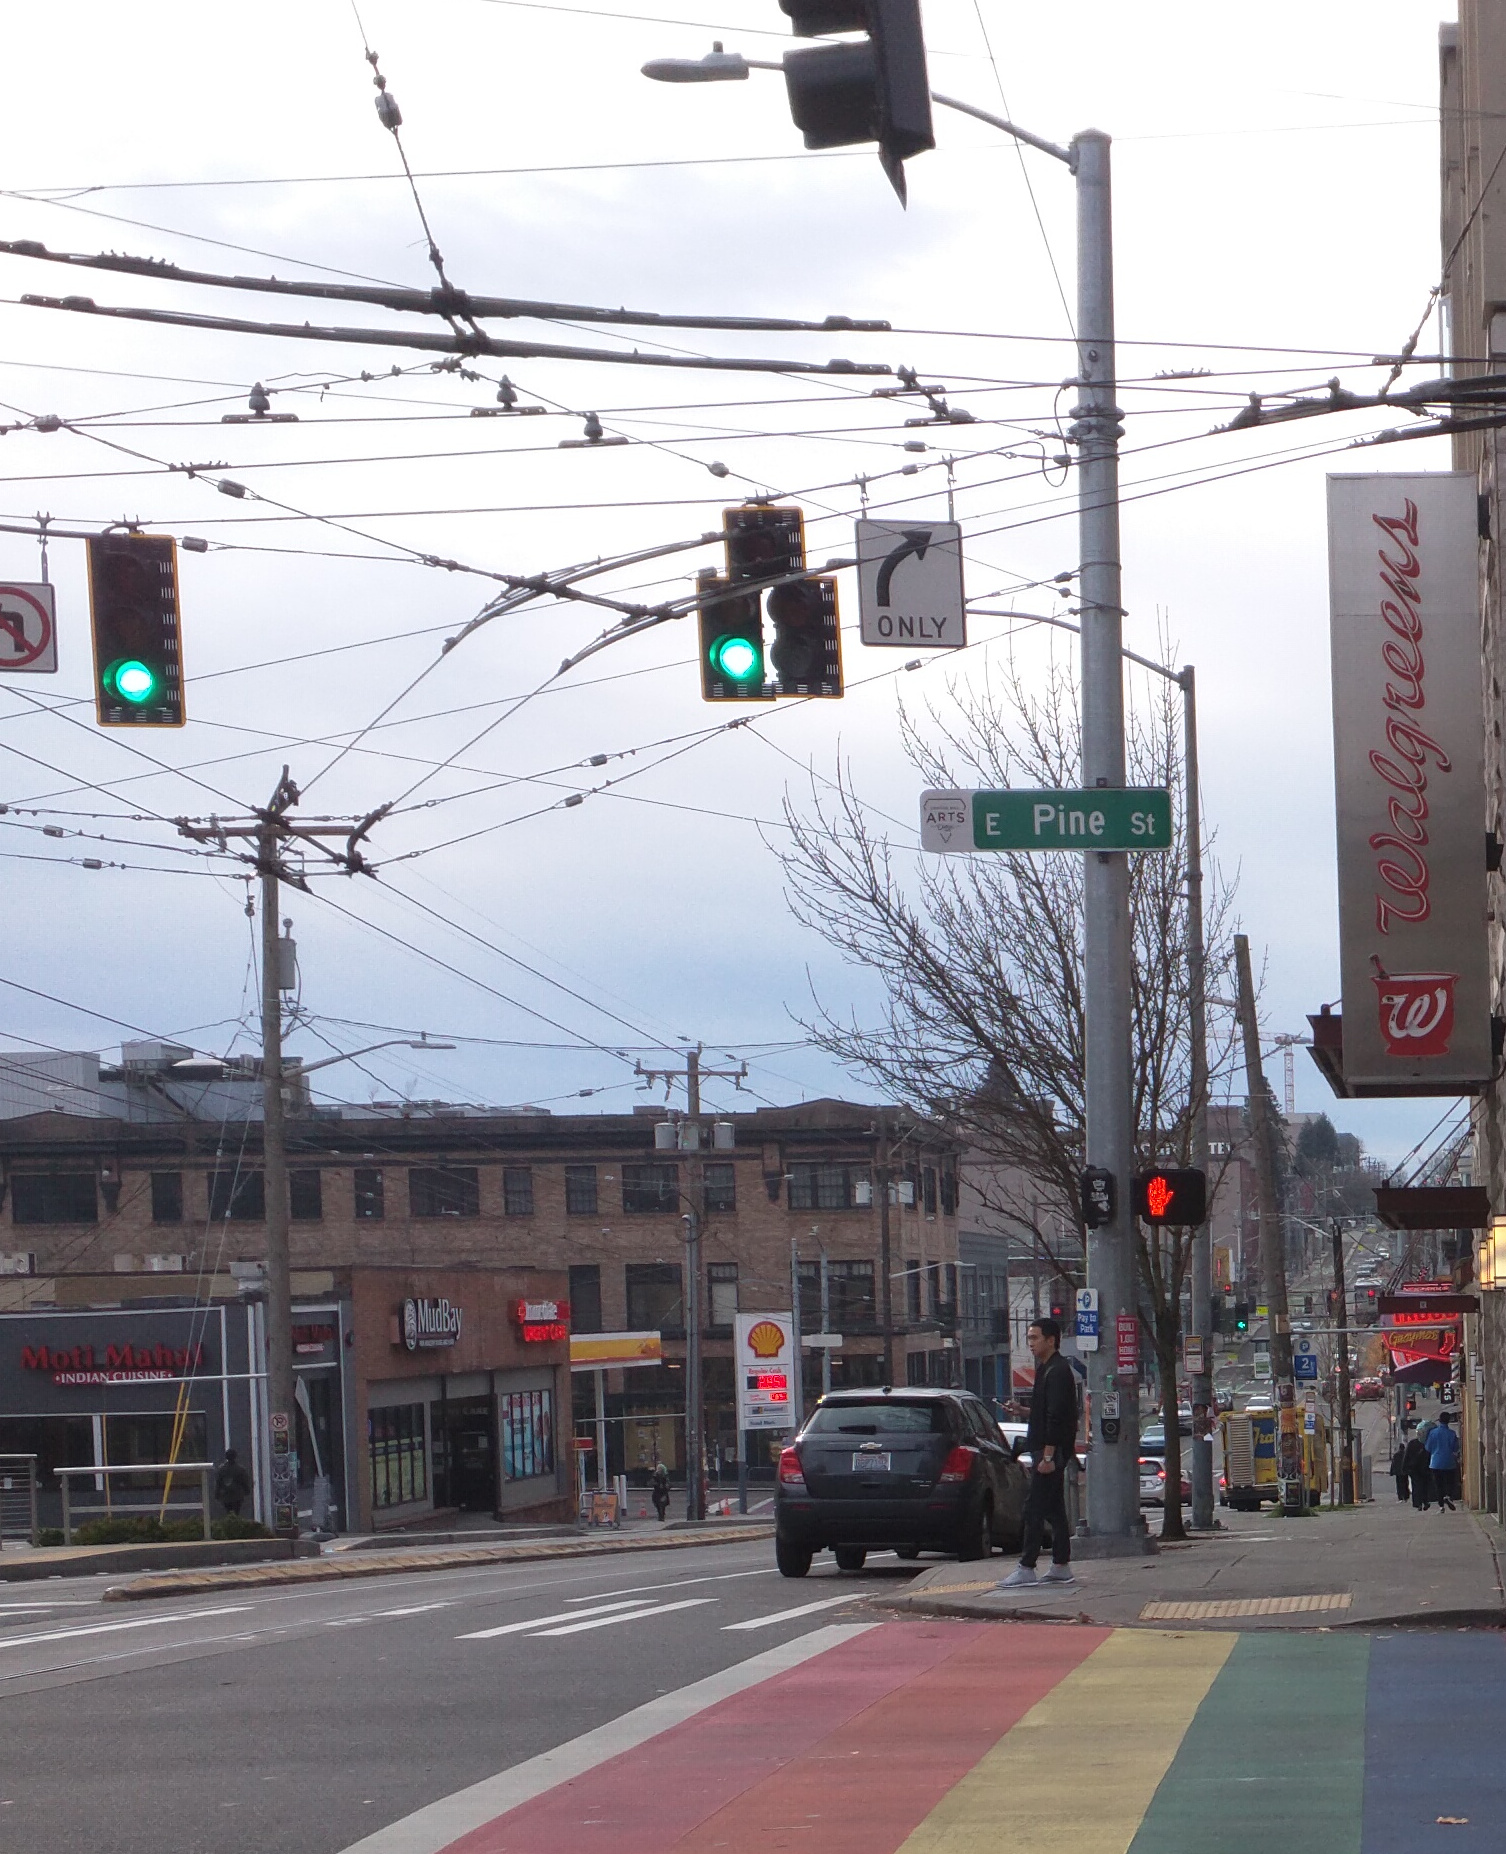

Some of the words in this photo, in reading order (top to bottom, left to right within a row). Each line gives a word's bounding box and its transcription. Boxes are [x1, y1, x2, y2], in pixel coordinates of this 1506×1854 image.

[877, 615, 947, 638] ONLY
[1369, 498, 1453, 936] Walgreens
[926, 812, 965, 823] ARTS
[986, 813, 1001, 836] E
[1033, 803, 1105, 836] Pine
[1131, 811, 1156, 836] St
[417, 1299, 462, 1341] MudBay
[1077, 1313, 1089, 1324] Pay
[1089, 1313, 1097, 1323] to
[1080, 1324, 1094, 1334] Park
[19, 1343, 95, 1369] Moti
[105, 1341, 204, 1368] Mahal
[1301, 1357, 1310, 1369] 2
[61, 1372, 109, 1384] INDIAN
[112, 1370, 167, 1382] CUISINE
